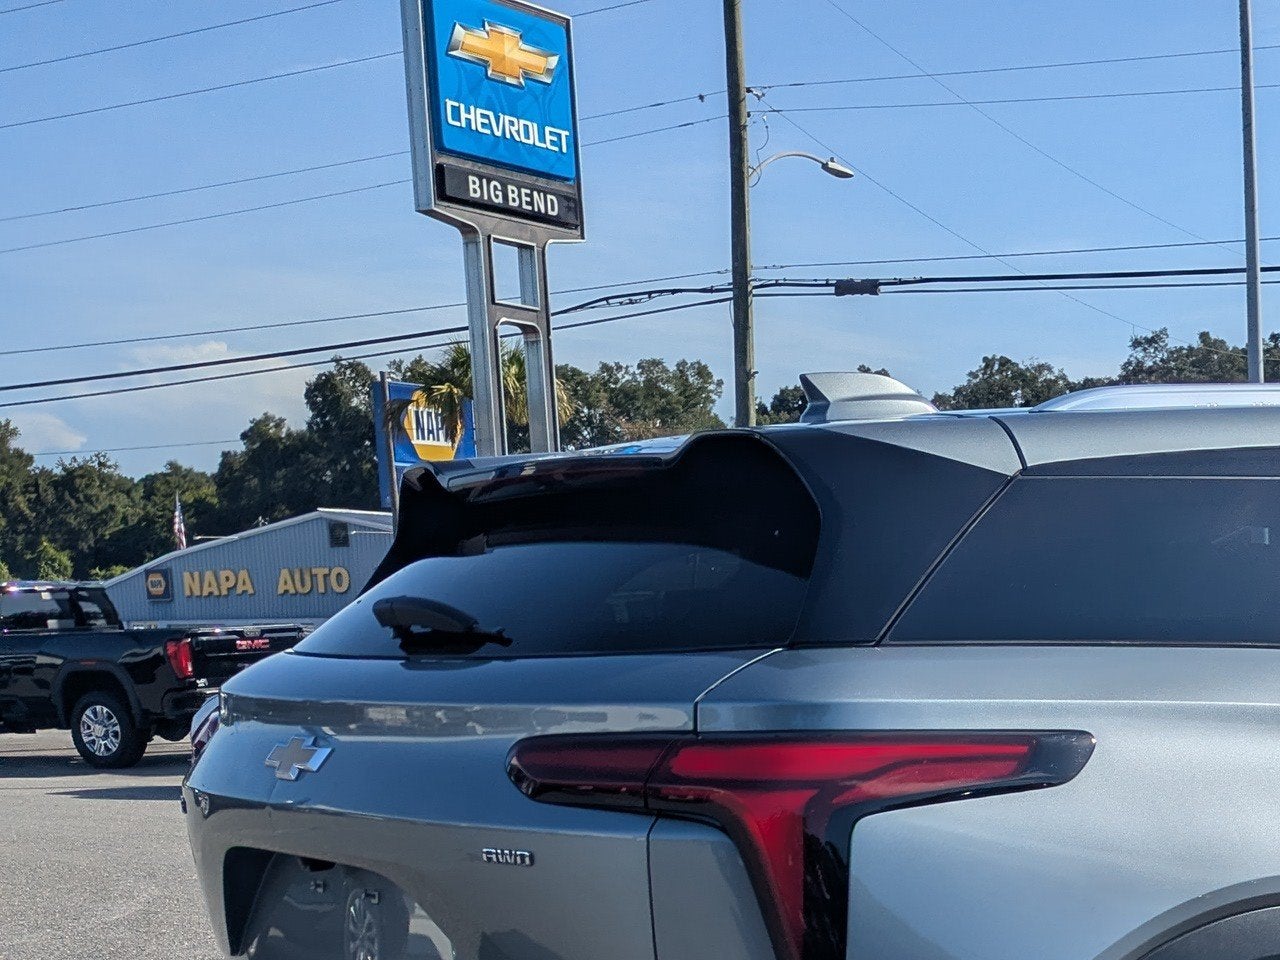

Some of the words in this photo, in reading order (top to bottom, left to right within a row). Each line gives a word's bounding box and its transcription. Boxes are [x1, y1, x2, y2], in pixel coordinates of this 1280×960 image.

[445, 98, 570, 154] CHEVROLET
[467, 174, 503, 204] BIG
[507, 184, 560, 217] BEND
[182, 568, 255, 598] NAPA
[277, 566, 351, 595] AUTO
[235, 639, 270, 650] GMC
